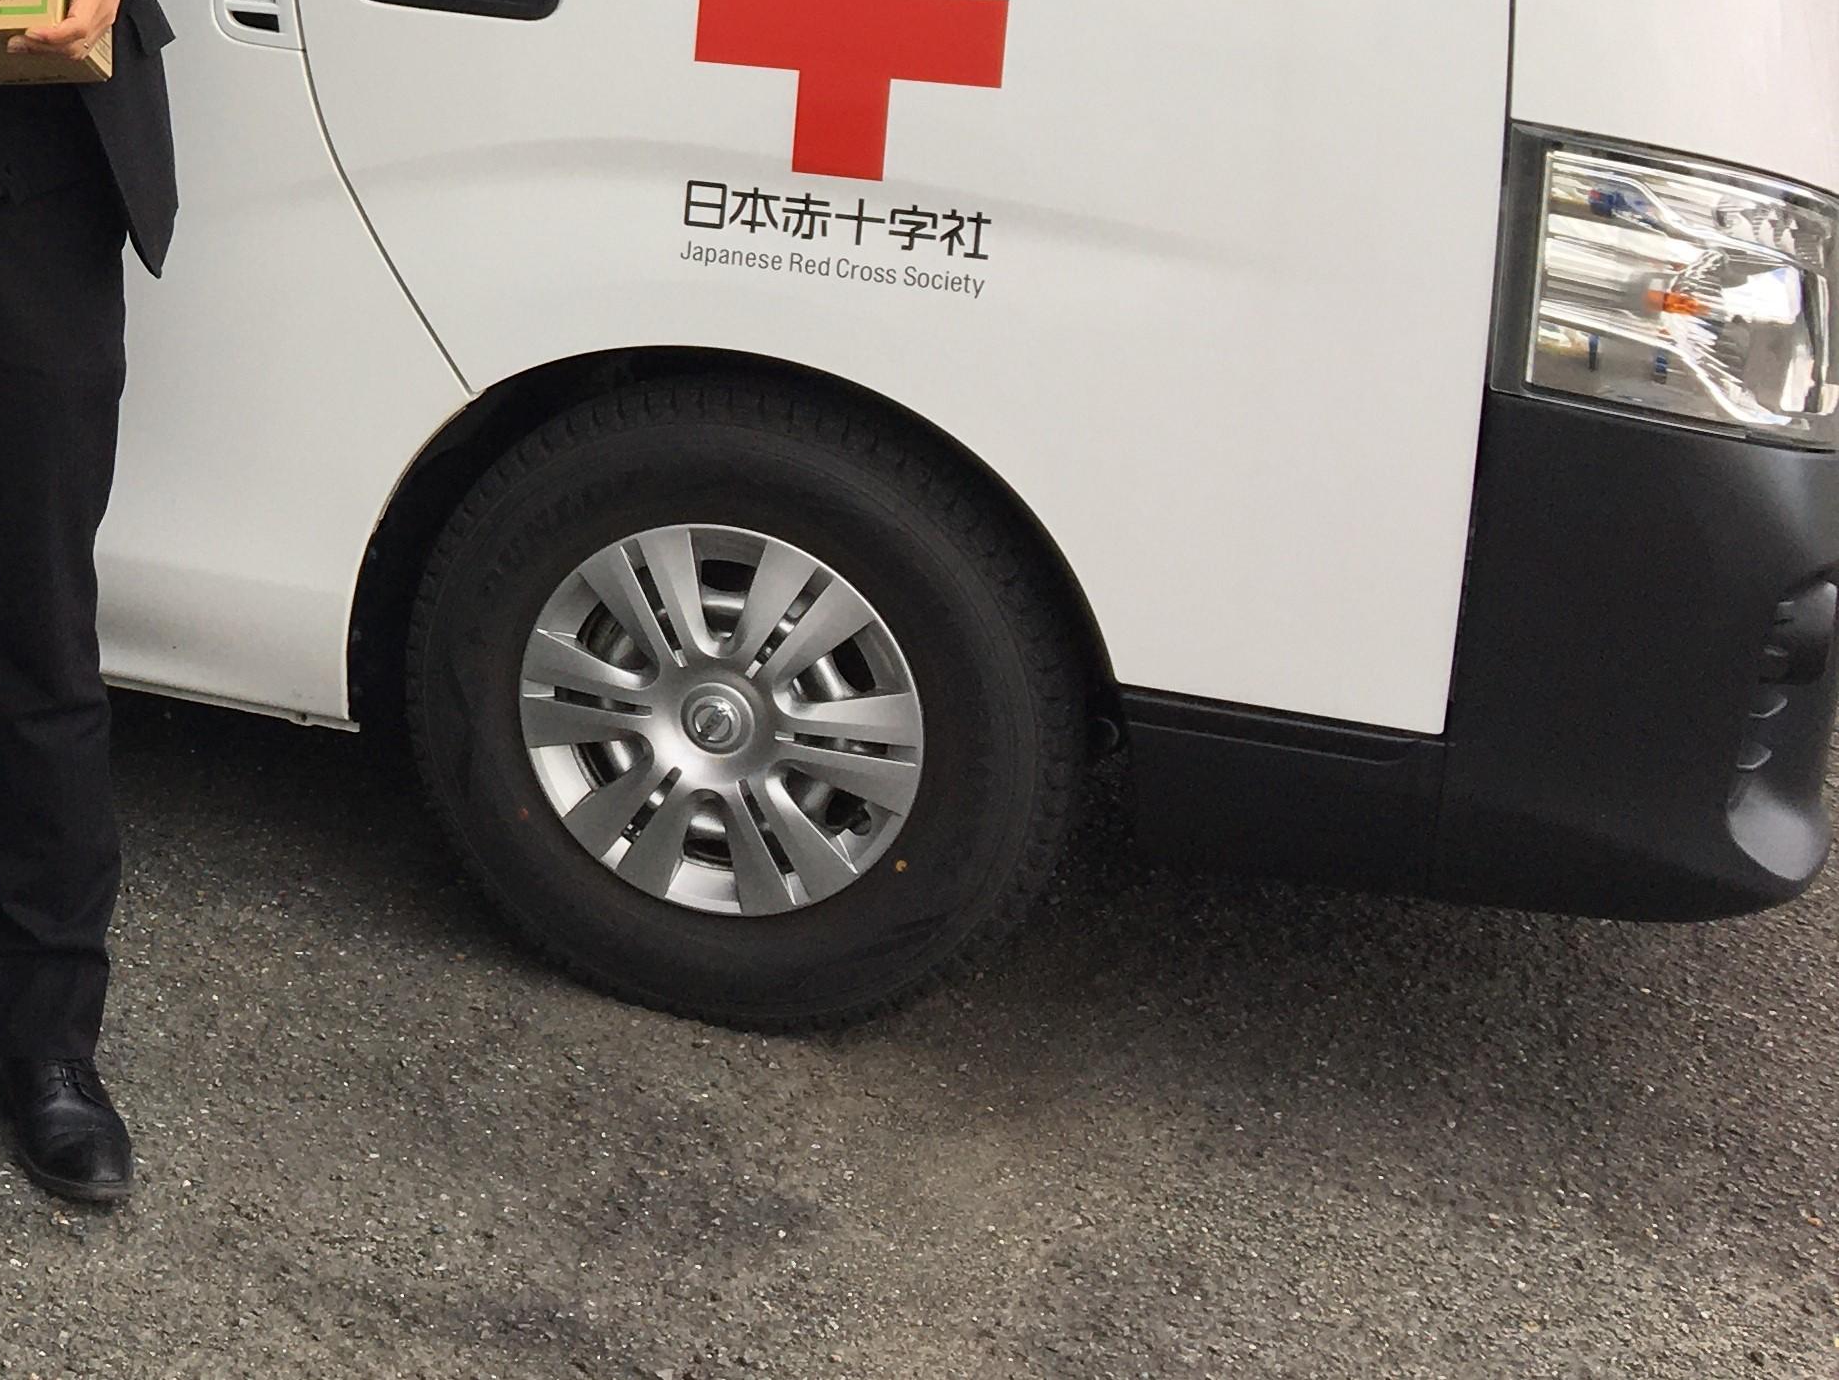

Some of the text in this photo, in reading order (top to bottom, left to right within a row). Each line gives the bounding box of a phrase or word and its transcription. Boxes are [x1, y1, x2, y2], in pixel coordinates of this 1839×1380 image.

[683, 180, 992, 260] 日本赤十字社
[680, 240, 986, 300] Japanese Red Cross Society
